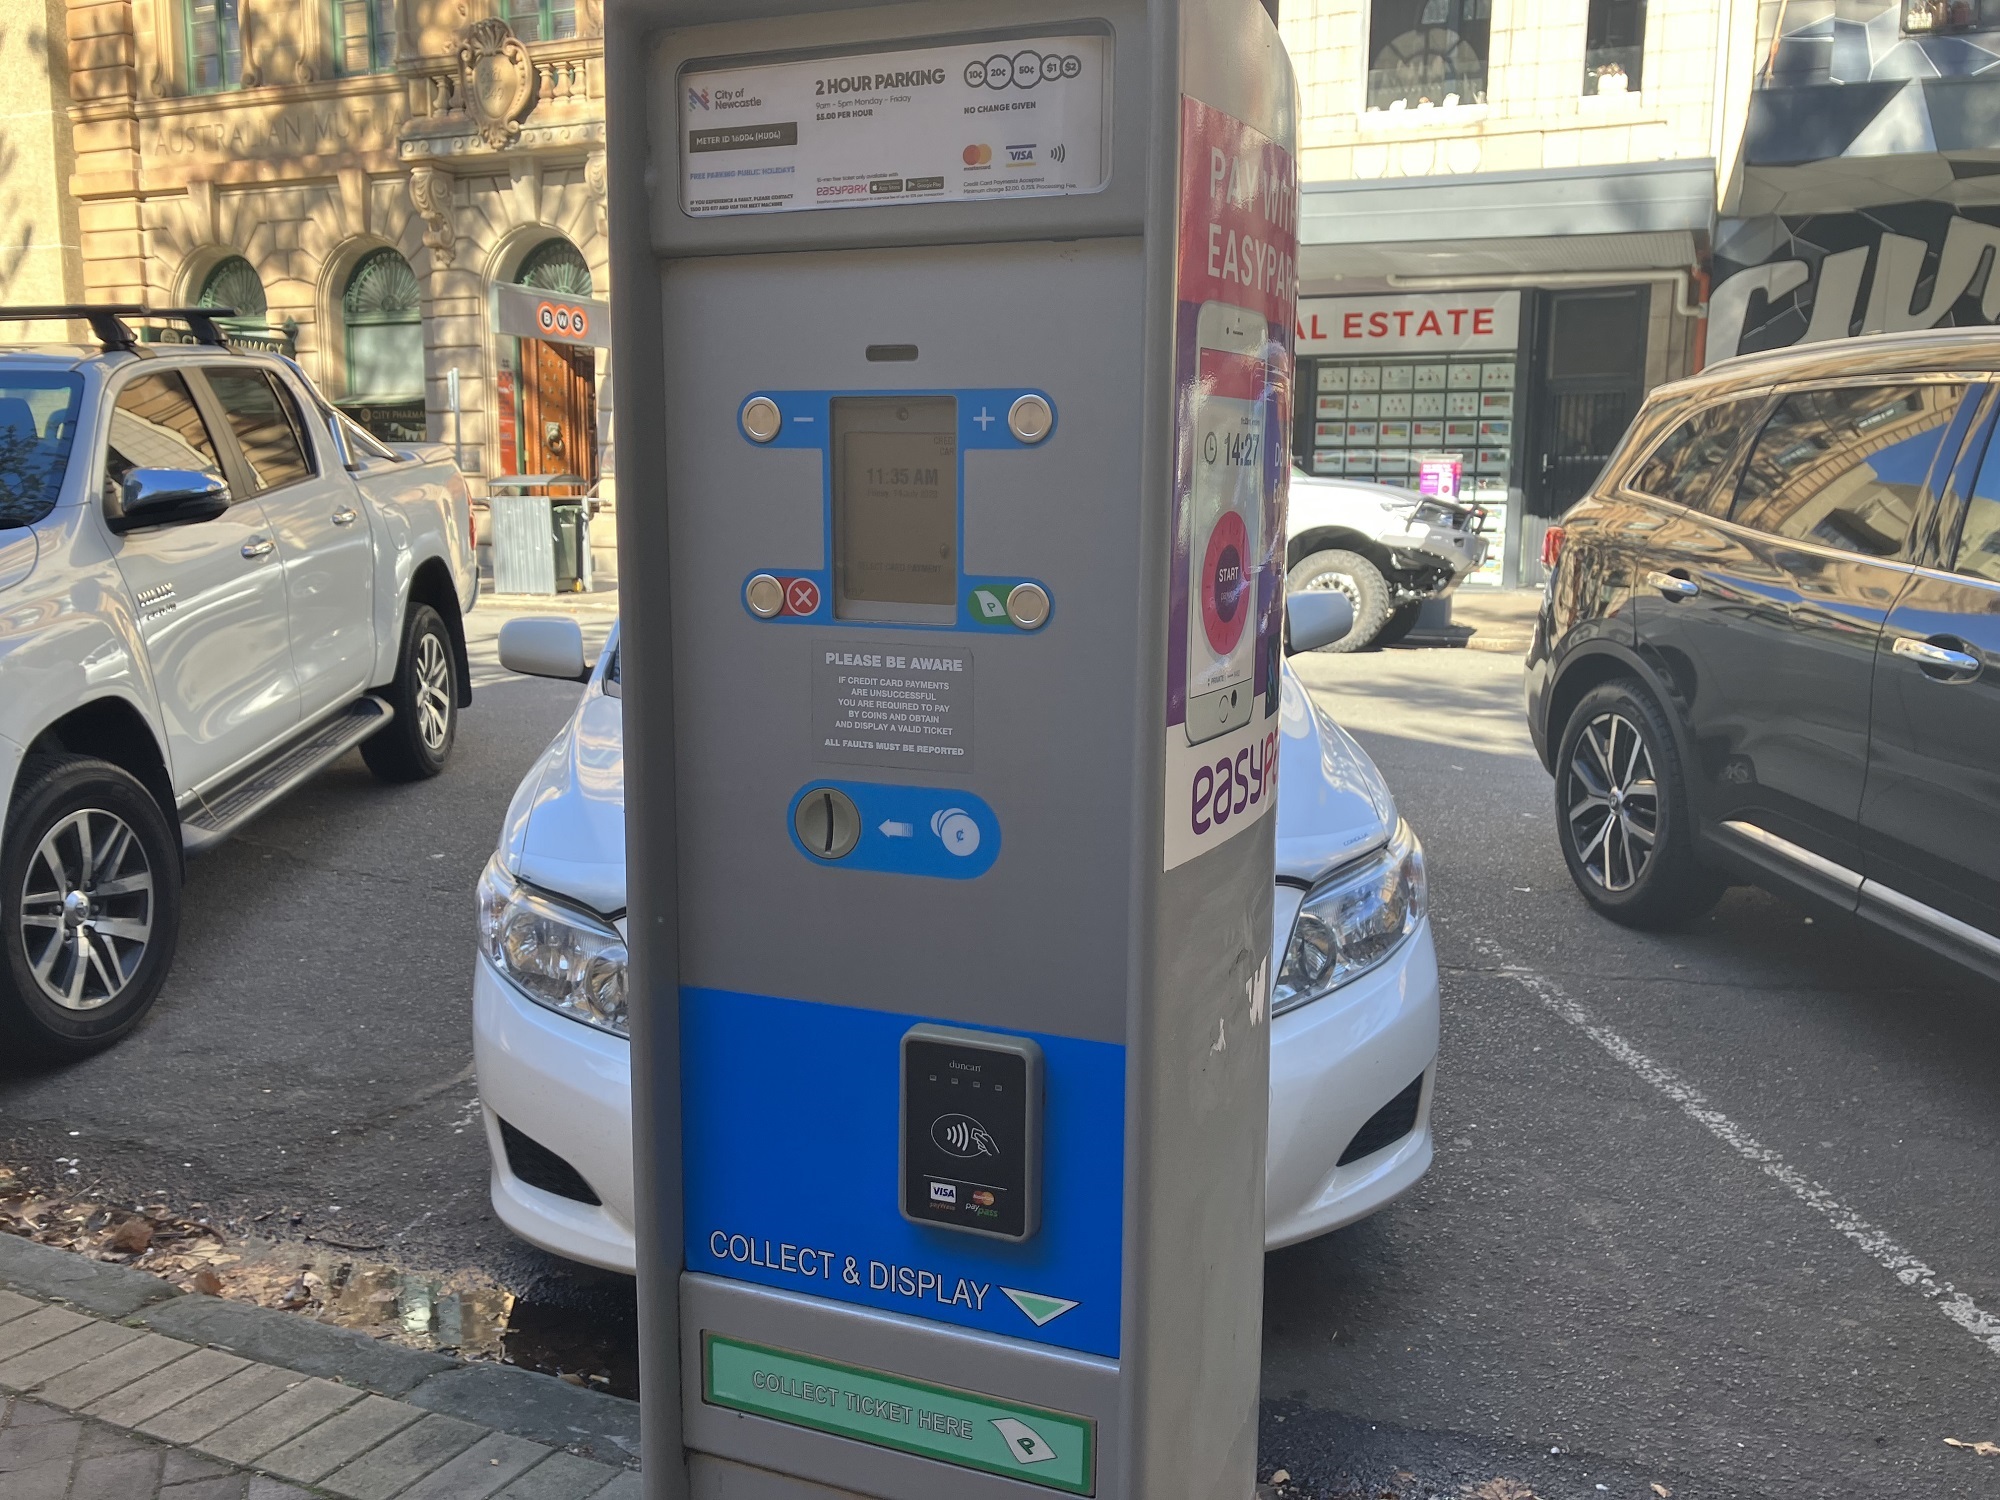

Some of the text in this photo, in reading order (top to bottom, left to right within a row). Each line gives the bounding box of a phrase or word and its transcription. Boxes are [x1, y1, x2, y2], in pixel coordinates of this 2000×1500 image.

[990, 68, 1006, 77] 20¢
[1018, 66, 1034, 74] 50¢
[1046, 62, 1057, 73] $1
[1064, 62, 1077, 72] $2
[815, 68, 946, 96] 2 HOUR PARKING
[714, 88, 745, 102] City of
[715, 97, 762, 110] Newcastle
[816, 102, 831, 110] 9am
[838, 100, 853, 109] 5pm
[854, 97, 883, 107] Monday
[890, 95, 912, 104] Friday
[964, 101, 1036, 115] NO CHANGE GIVEN
[838, 111, 852, 119] PER
[852, 109, 873, 118] HOUR
[154, 115, 302, 157] AUSTRALIAN
[696, 136, 721, 146] METER
[722, 135, 730, 144] ID
[1009, 150, 1033, 161] VISA
[690, 166, 796, 180] FREE PARKING PUBLIC HOLIDAYS
[1209, 146, 1259, 213] PAY
[994, 178, 1018, 186] Payments
[1343, 308, 1494, 339] ESTATE
[372, 410, 425, 420] CITY PHARMA
[1224, 432, 1260, 466] 14:27
[866, 467, 938, 486] 11:35 AM
[906, 562, 943, 574] PAYMENT
[1218, 566, 1239, 583] START
[825, 652, 963, 672] PLEASE BE AWARE
[838, 676, 950, 690] IF CREDIT CARD PAYMENTS
[851, 688, 937, 701] ARE UNSUCCESSFUL
[838, 698, 950, 713] YOU ARE REQUIRED TO PAY
[848, 710, 940, 724] BY COINS AND OBTAIN
[835, 720, 953, 736] AND DISPLAY A VALID TICKET
[824, 738, 965, 756] ALL FAULTS MUST BE REPORTED
[949, 1060, 982, 1073] duncan
[933, 1186, 956, 1199] VISA
[709, 1230, 990, 1311] COLLECT & DISPLAY
[752, 1370, 974, 1441] COLLECT TICKET HERE
[1017, 1437, 1037, 1456] P
